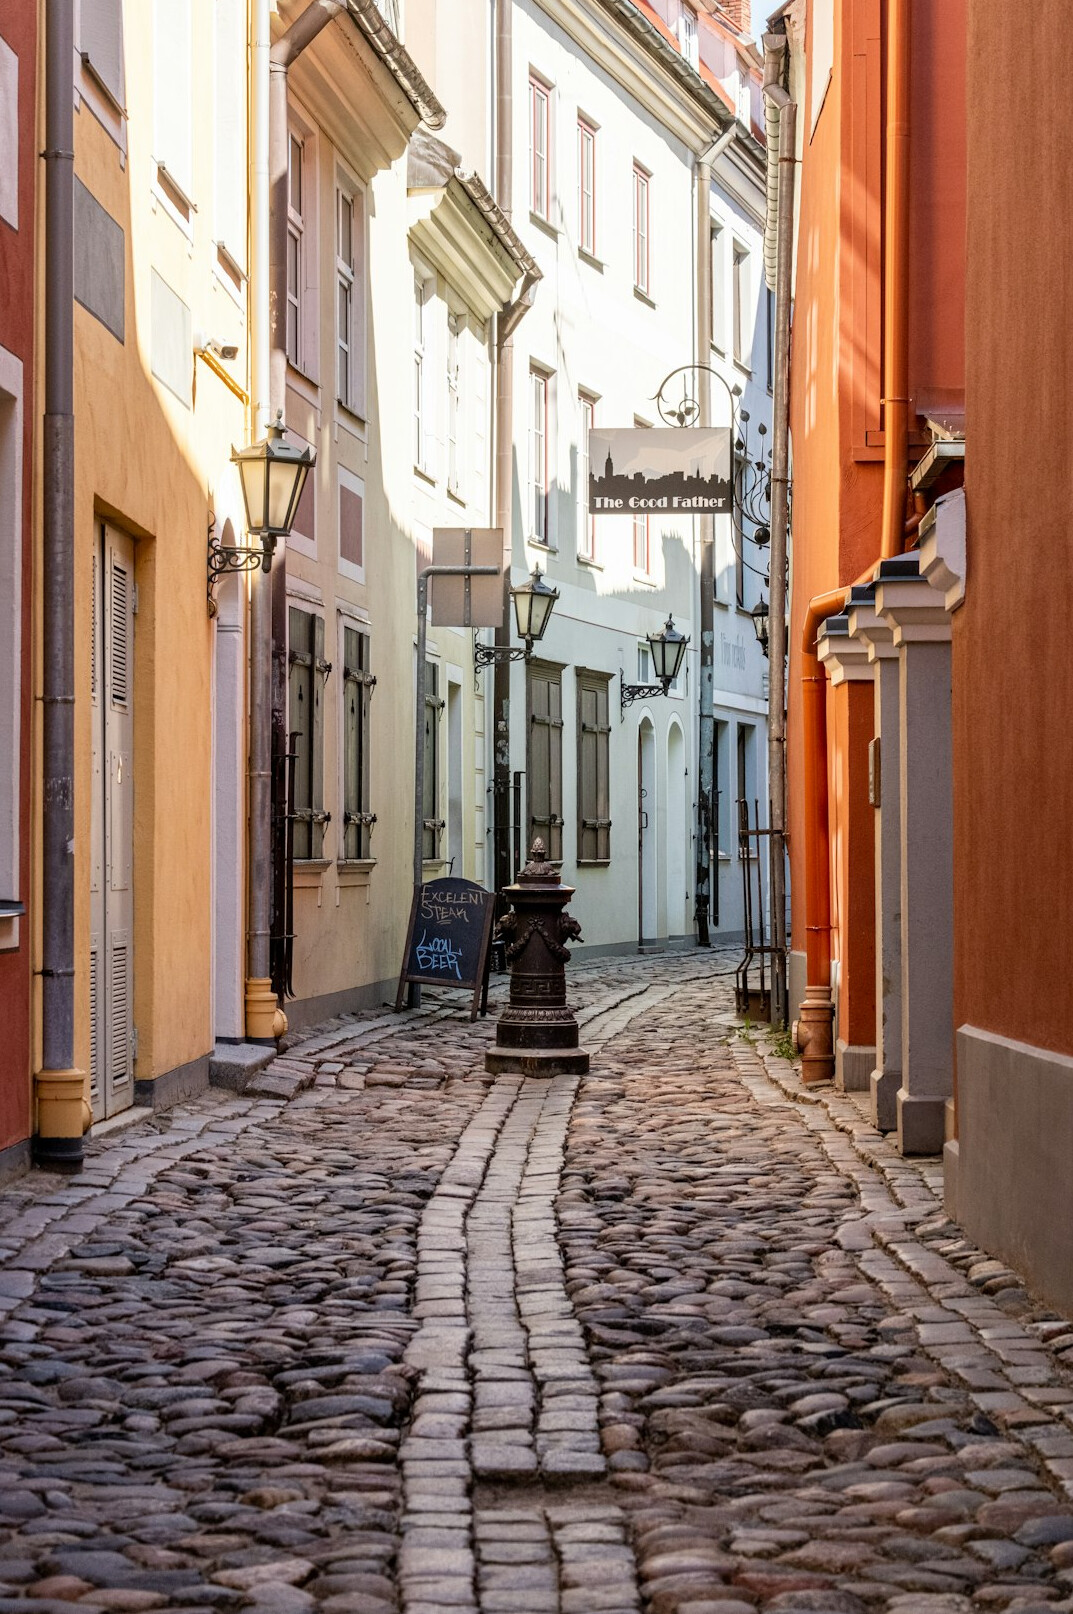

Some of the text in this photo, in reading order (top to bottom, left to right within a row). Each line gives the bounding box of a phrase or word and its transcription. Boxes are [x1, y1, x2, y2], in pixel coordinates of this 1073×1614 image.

[593, 496, 726, 508] The Good Father
[421, 901, 469, 922] STEAK
[416, 929, 463, 956] LOCAL
[416, 948, 462, 980] BEER
